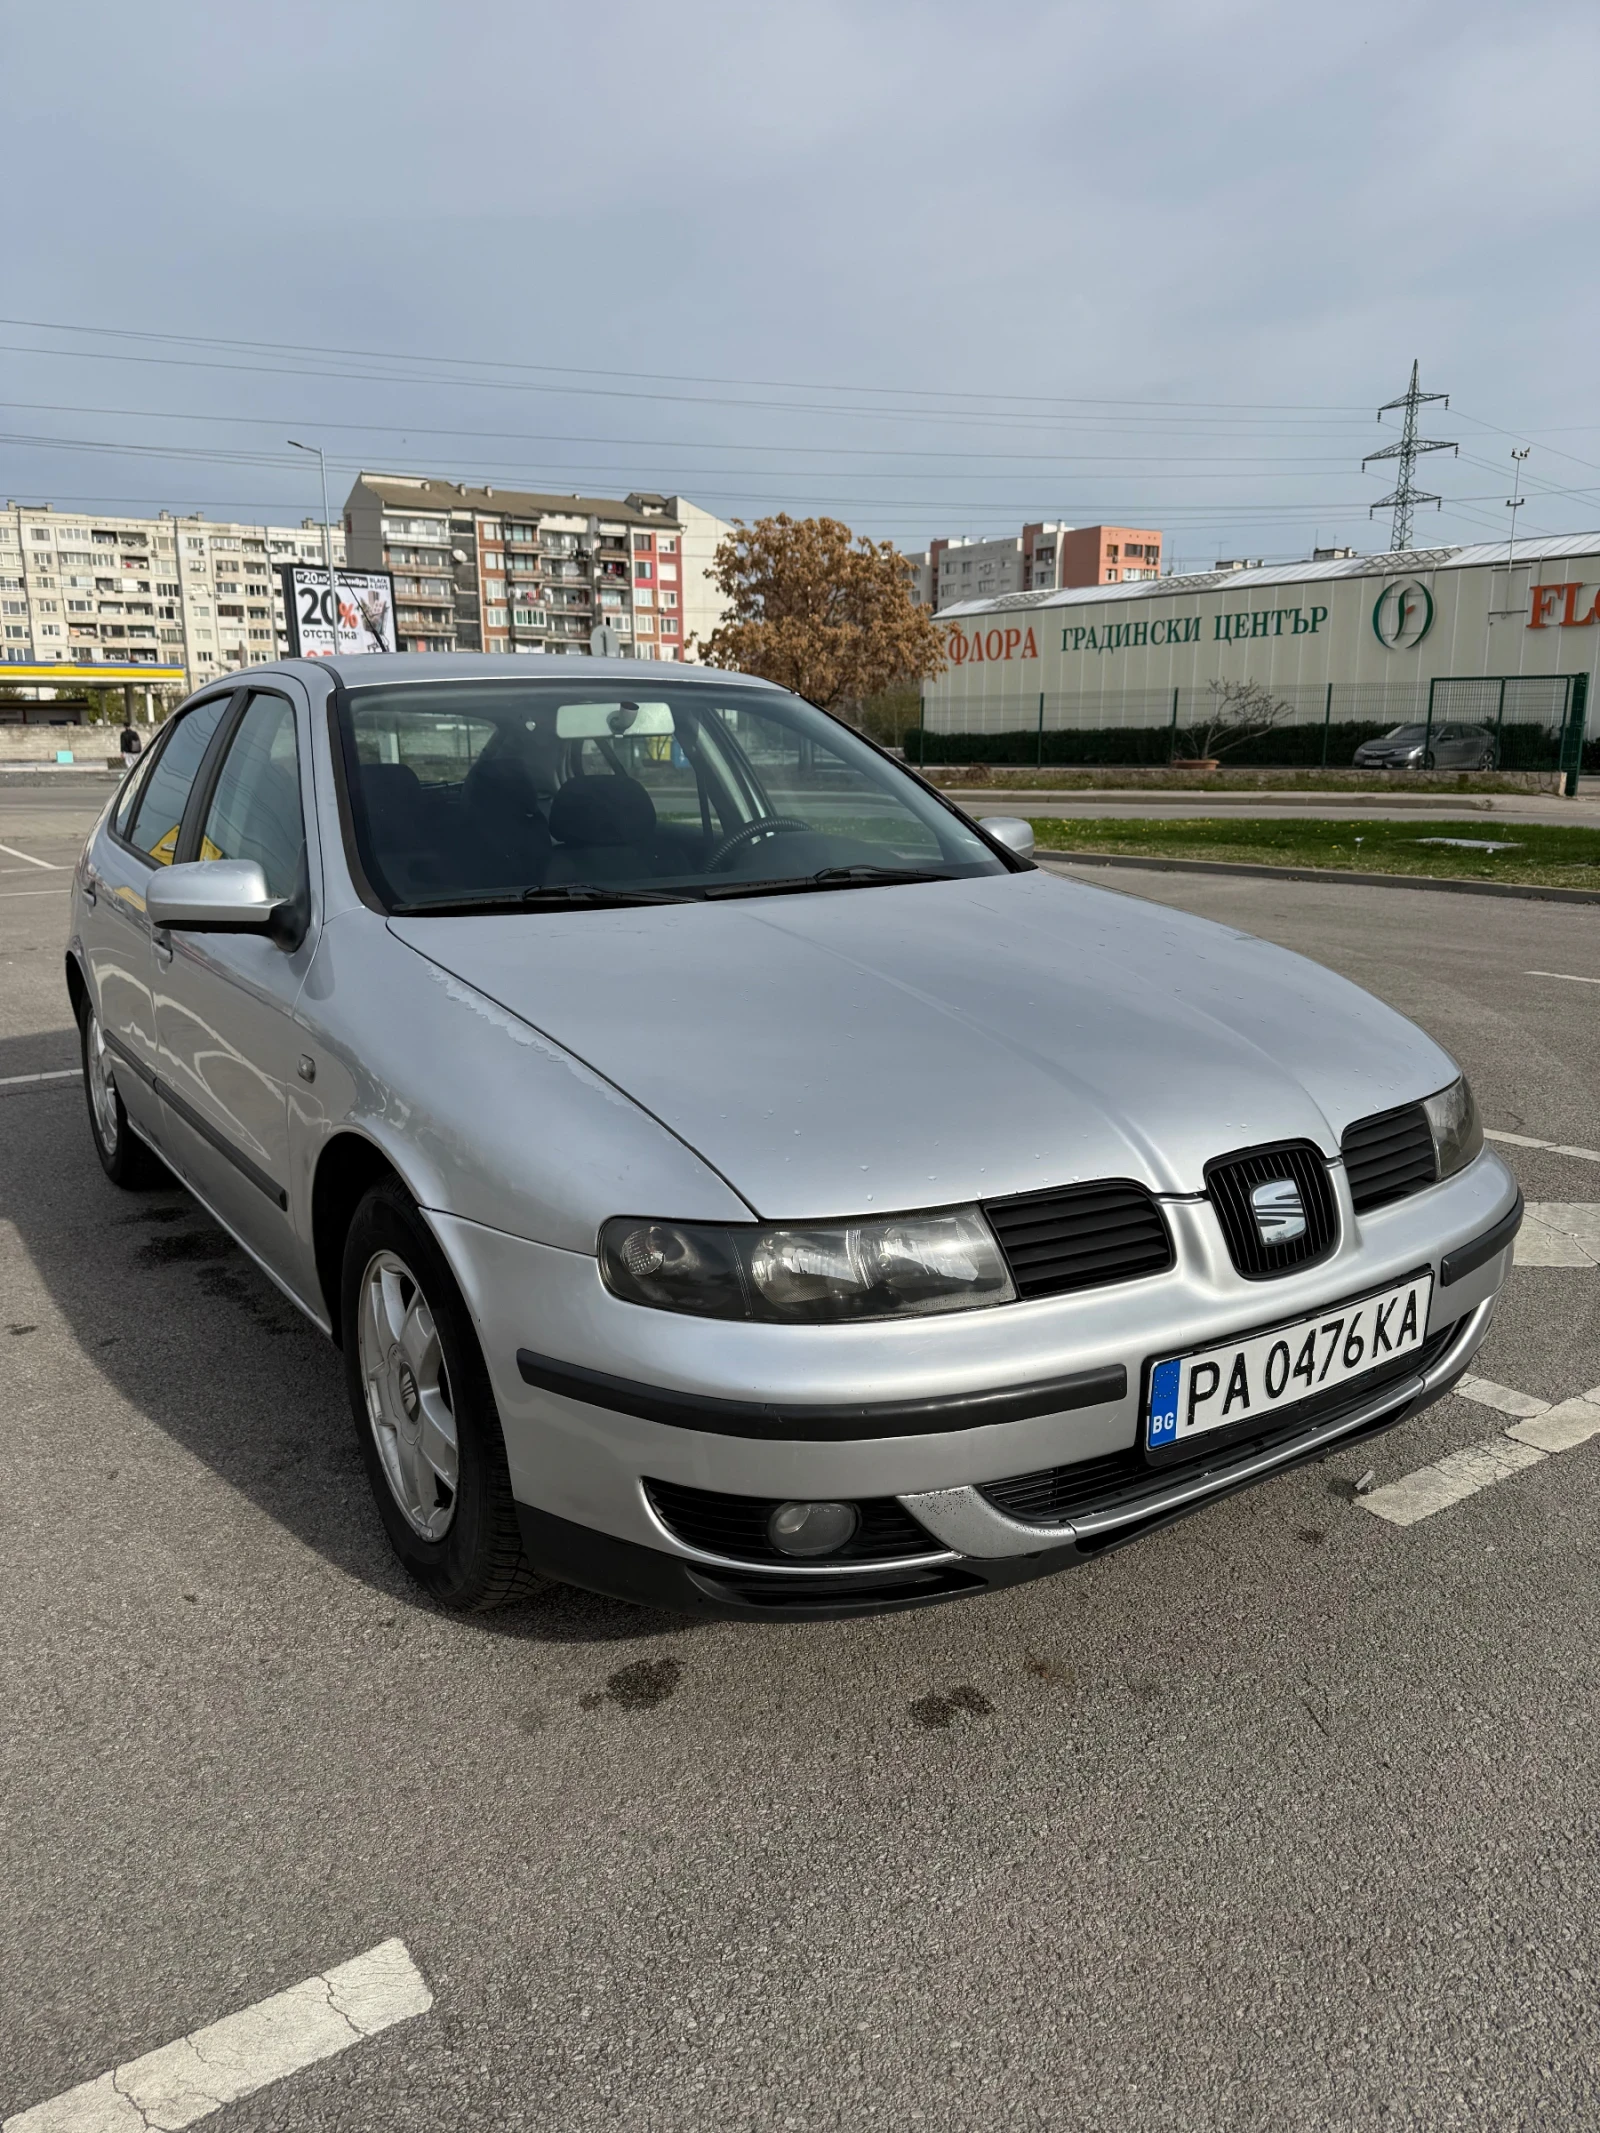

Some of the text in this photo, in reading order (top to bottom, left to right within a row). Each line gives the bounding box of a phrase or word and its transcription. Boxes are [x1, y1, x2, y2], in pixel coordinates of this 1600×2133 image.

[304, 572, 318, 584] 20
[1526, 582, 1600, 629] FL
[948, 606, 1328, 665] ФЛОРА ГРАДИНСКИ ЦЕНТЪР
[1152, 1413, 1175, 1435] BG
